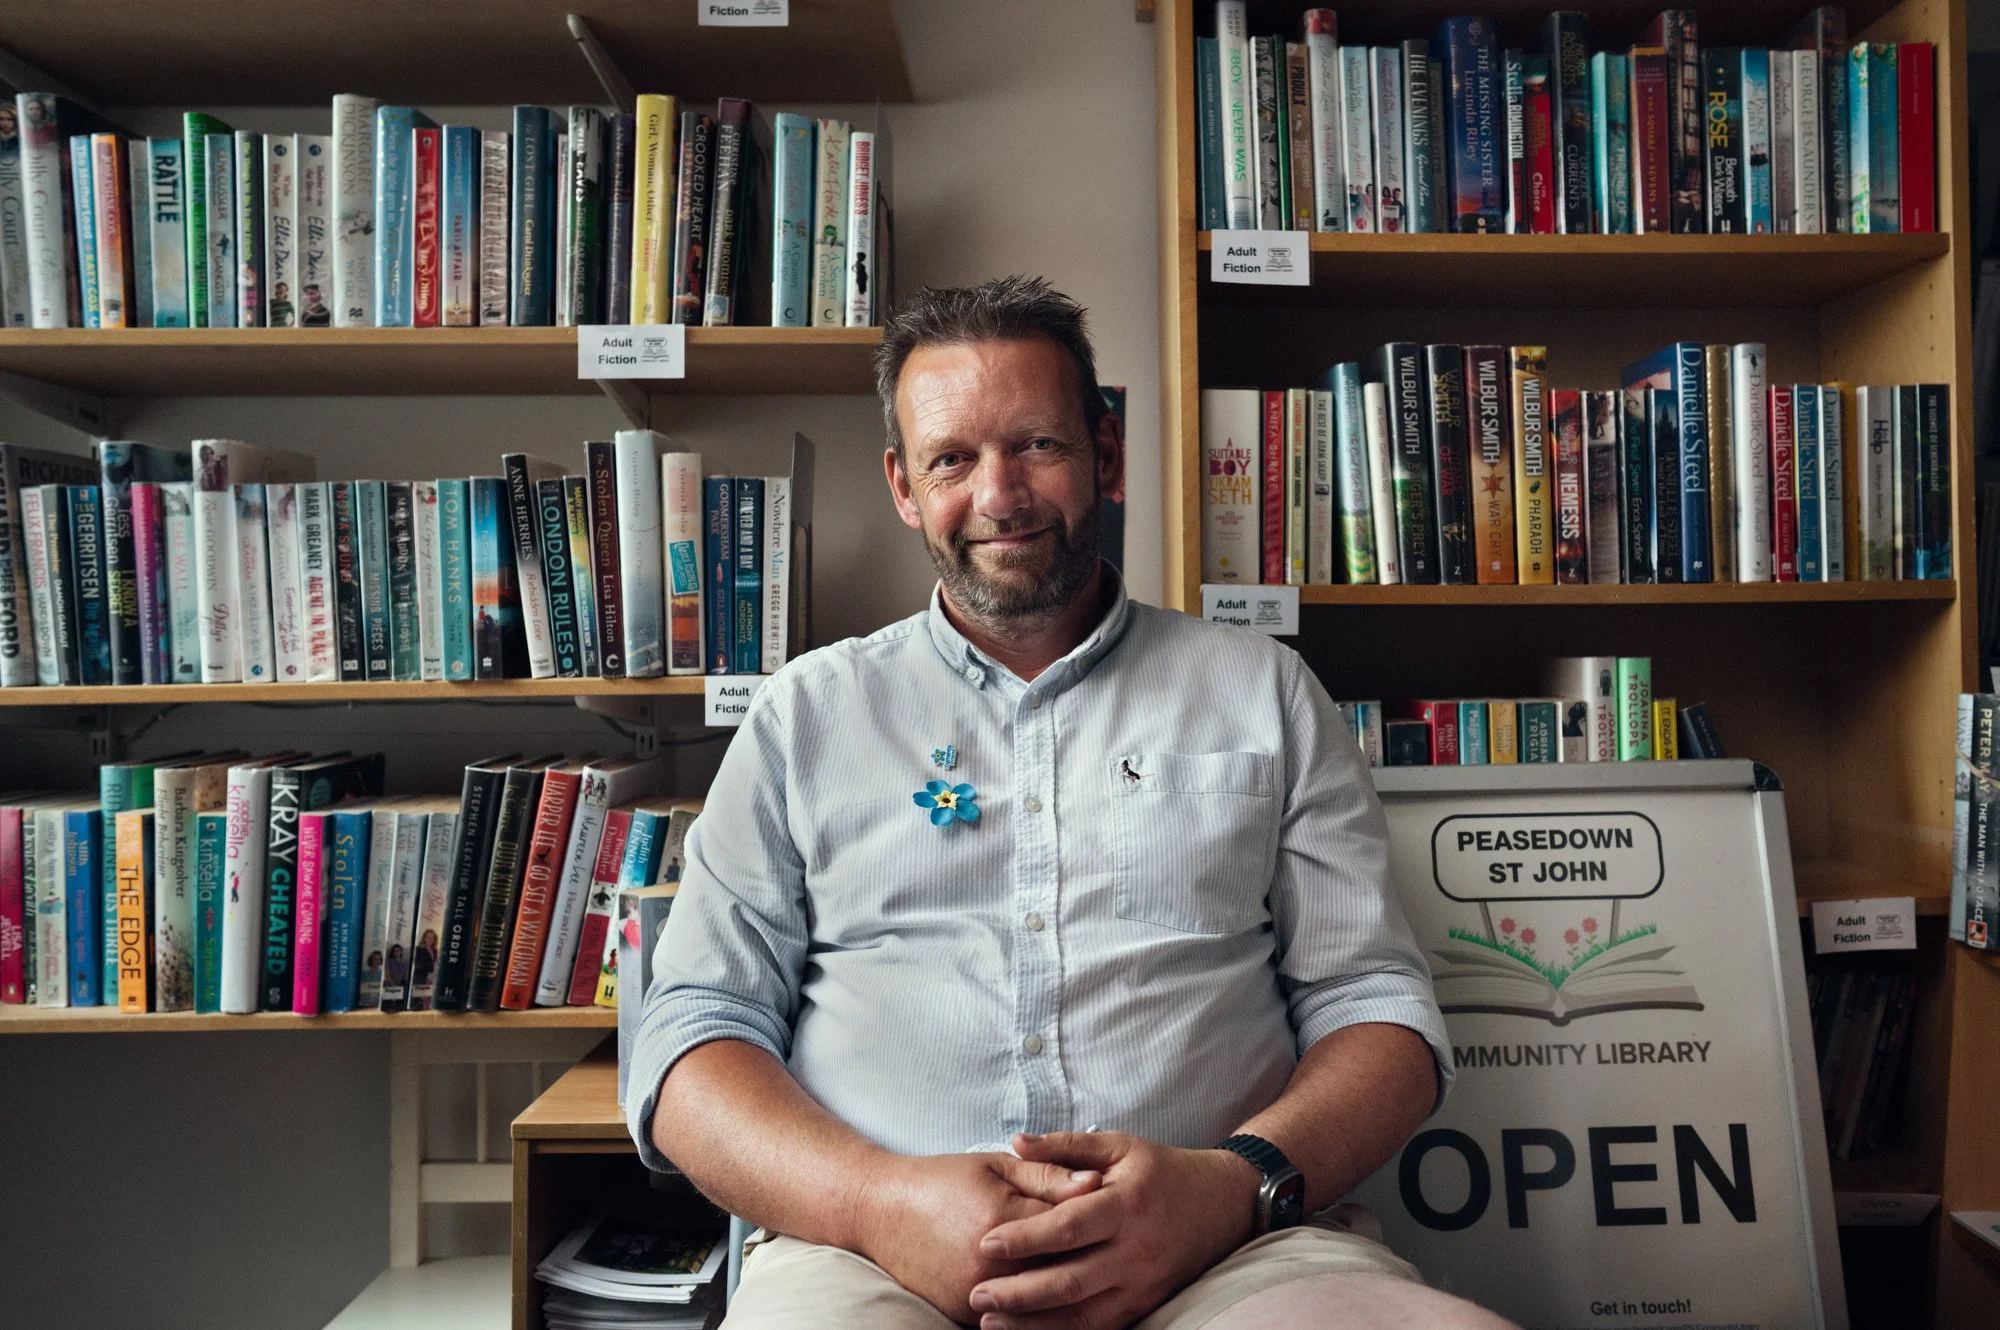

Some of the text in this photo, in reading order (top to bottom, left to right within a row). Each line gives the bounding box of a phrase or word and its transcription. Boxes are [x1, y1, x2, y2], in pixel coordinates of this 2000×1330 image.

[710, 6, 748, 16] Fiction
[1291, 65, 1306, 106] PROULX
[1409, 54, 1428, 146] THE EVENINGS
[1507, 62, 1523, 104] Stella
[1464, 70, 1478, 161] Lucinda Riley
[1478, 46, 1493, 187] THE MISSING SISTER
[1509, 104, 1523, 159] RIMINGTON
[1708, 91, 1728, 148] ROSE
[1800, 55, 1818, 221] GEORGE SAUNDERS
[342, 103, 355, 197] DICKINSON
[524, 138, 536, 169] LOST
[646, 114, 658, 188] Girl, Woman,
[717, 125, 733, 191] FEEHAN
[856, 141, 870, 177] BRIDGET
[1234, 149, 1246, 182] WAS
[1567, 144, 1580, 209] CURRENTS
[1832, 130, 1845, 200] INVICTUS
[156, 155, 179, 223] RATTLE
[575, 161, 586, 203] EAVES
[691, 126, 707, 240] CROOKED HEART
[1531, 172, 1543, 212] Choice
[1713, 155, 1725, 216] Dark Waters
[1725, 157, 1738, 203] Beneath
[2, 196, 21, 246] Court
[31, 190, 48, 239] Court
[453, 245, 462, 281] AFFAIR
[1223, 263, 1261, 273] Fiction
[1227, 247, 1257, 256] Adult
[598, 355, 637, 364] Fiction
[602, 337, 632, 348] Adult
[1400, 356, 1420, 455] WILBUR SMITH
[1434, 373, 1449, 424] SMITH
[1681, 347, 1705, 493] Danielle Steel
[1749, 374, 1765, 479] Danielle Steel
[1823, 390, 1839, 457] Danielle
[1208, 449, 1252, 459] SUITABLE
[1478, 360, 1502, 556] WILBUR SMITH WAR CRY
[1775, 391, 1793, 501] Danielle Steel
[1798, 389, 1817, 500] Danielle Steel
[1870, 419, 1889, 455] Help
[1208, 476, 1251, 489] VIKRAM
[1209, 460, 1251, 475] BOY
[1523, 378, 1543, 555] WILBUR SMITH PHARAOH
[1826, 459, 1840, 501] Steel
[117, 508, 131, 538] Tess
[711, 509, 720, 535] PARK
[720, 483, 730, 561] GODMERSHAM
[1207, 489, 1252, 506] SETH
[1560, 472, 1580, 539] NEMESIS
[26, 493, 47, 589] FELIX FRANCIS
[77, 513, 99, 599] GERRITSEN
[105, 496, 119, 564] Gerritsen
[305, 488, 325, 609] MARK GREANEY AGENT
[445, 489, 461, 604] TOM HANKS
[510, 465, 540, 617] ANNE HERRIES Forbidden
[595, 468, 617, 643] Stolen Queen Lisa Hilton
[1632, 497, 1644, 563] Erica Spindler
[108, 570, 122, 616] SECRET
[122, 578, 136, 616] KNOW
[174, 554, 188, 592] WALL
[542, 495, 574, 655] LONDON RULES
[770, 494, 785, 651] Nowhere Man HURWITZ
[54, 579, 69, 649] DAMON GALGUT
[369, 572, 383, 651] MISSING PIECES
[738, 599, 746, 644] HOROWITZ
[1212, 616, 1251, 627] Fiction
[1216, 599, 1247, 609] Adult
[715, 703, 751, 714] Fictio
[719, 687, 749, 696] Adult
[1628, 674, 1639, 749] TROLLOPE
[1640, 681, 1649, 742] JOANNA
[1540, 721, 1548, 762] ADRIAN
[240, 799, 254, 836] sophie
[1976, 707, 1994, 876] PETER THE MAN WITH
[171, 787, 189, 899] Barbara Kingsolver
[227, 784, 245, 859] kinsella
[301, 826, 318, 858] NEVER
[625, 820, 646, 871] LENNOX
[638, 832, 653, 864] Judith
[1456, 828, 1634, 853] PEASEDOWN
[120, 864, 139, 906] THE
[198, 838, 216, 901] kinsella
[268, 783, 299, 976] KRAY CHEATED
[333, 833, 353, 910] Stolen
[448, 785, 483, 964] STEPHEN LEATHER TALL ORDER
[509, 779, 568, 987] HARPER LEE GO SET WATCHMAN
[564, 815, 597, 914] Maureen Flora
[1489, 861, 1608, 884] ST JOHN
[299, 901, 315, 945] COMING
[476, 840, 519, 978] OUR TRAITOR
[1837, 916, 1866, 926] Adult
[12, 925, 21, 952] LISA
[121, 917, 140, 979] EDGE
[1833, 934, 1871, 943] Fiction
[1453, 1041, 1713, 1068] MMUNITY LIBRARY
[1398, 1123, 1757, 1231] OPEN
[1590, 1299, 1692, 1316] Get in touch!
